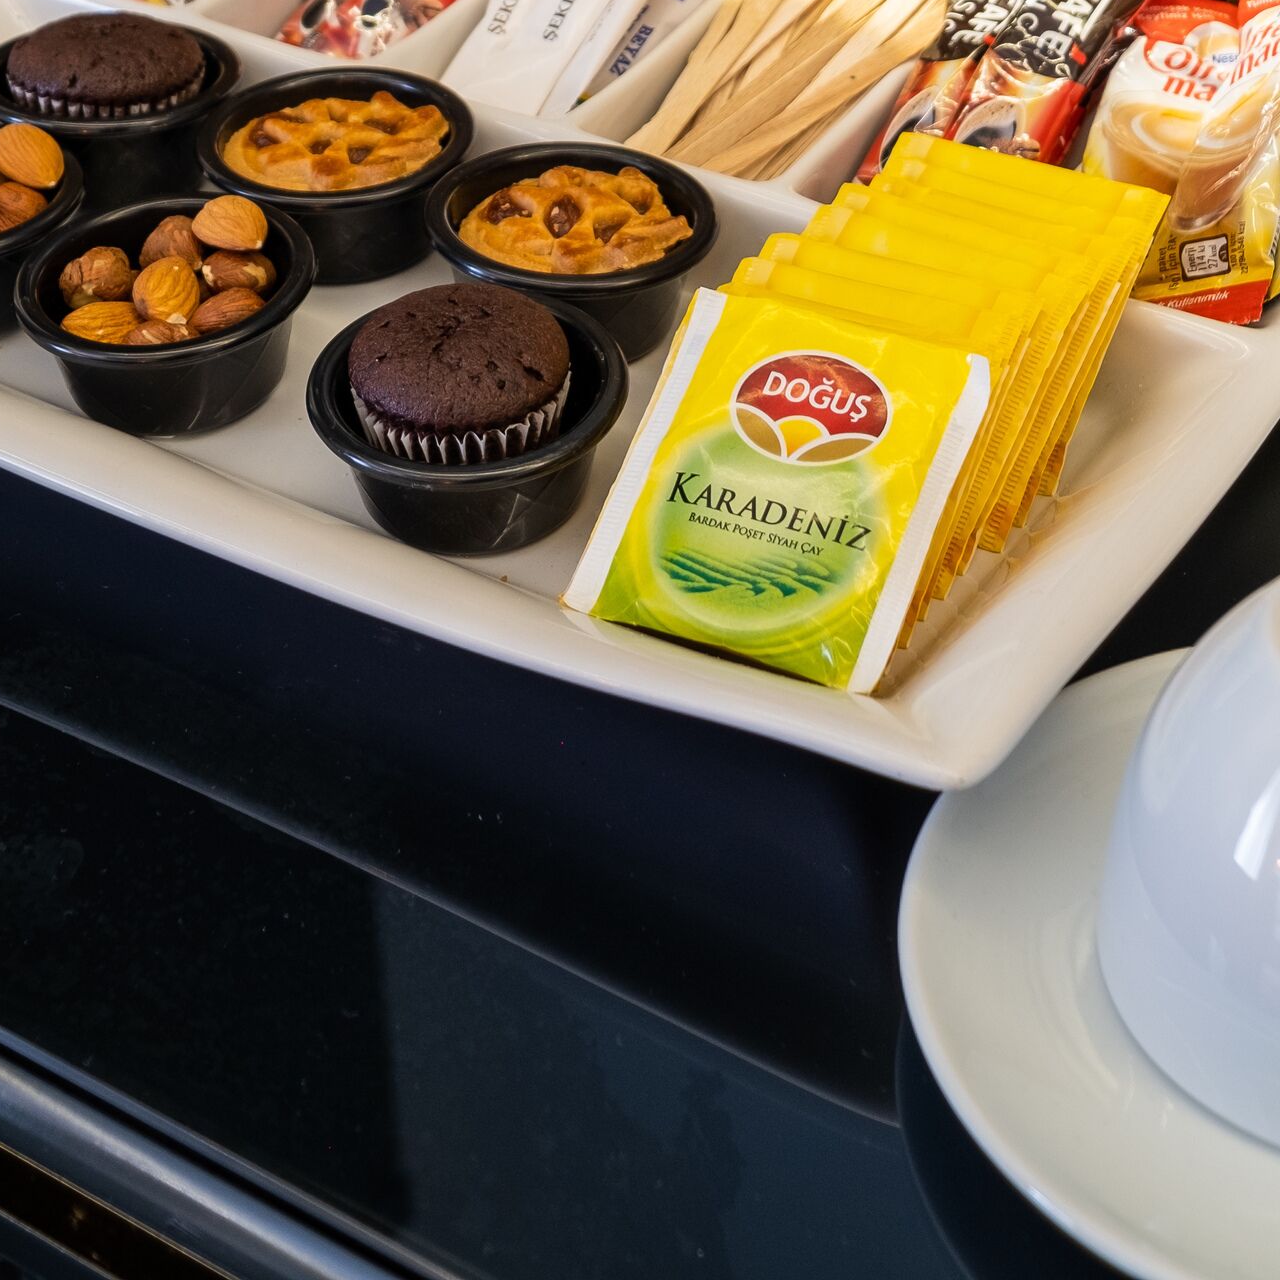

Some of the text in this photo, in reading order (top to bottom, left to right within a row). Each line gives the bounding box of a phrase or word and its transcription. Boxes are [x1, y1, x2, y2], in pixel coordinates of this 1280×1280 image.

[611, 24, 654, 76] BEYAZ
[1163, 75, 1217, 102] ma
[1185, 247, 1198, 273] Enerji
[1197, 255, 1207, 271] 114
[1207, 258, 1218, 269] 27
[762, 371, 872, 422] DOĞUŞ
[667, 472, 872, 551] KARADENİZ
[689, 512, 824, 557] BARDAK POŞET SİYAH ÇAY
